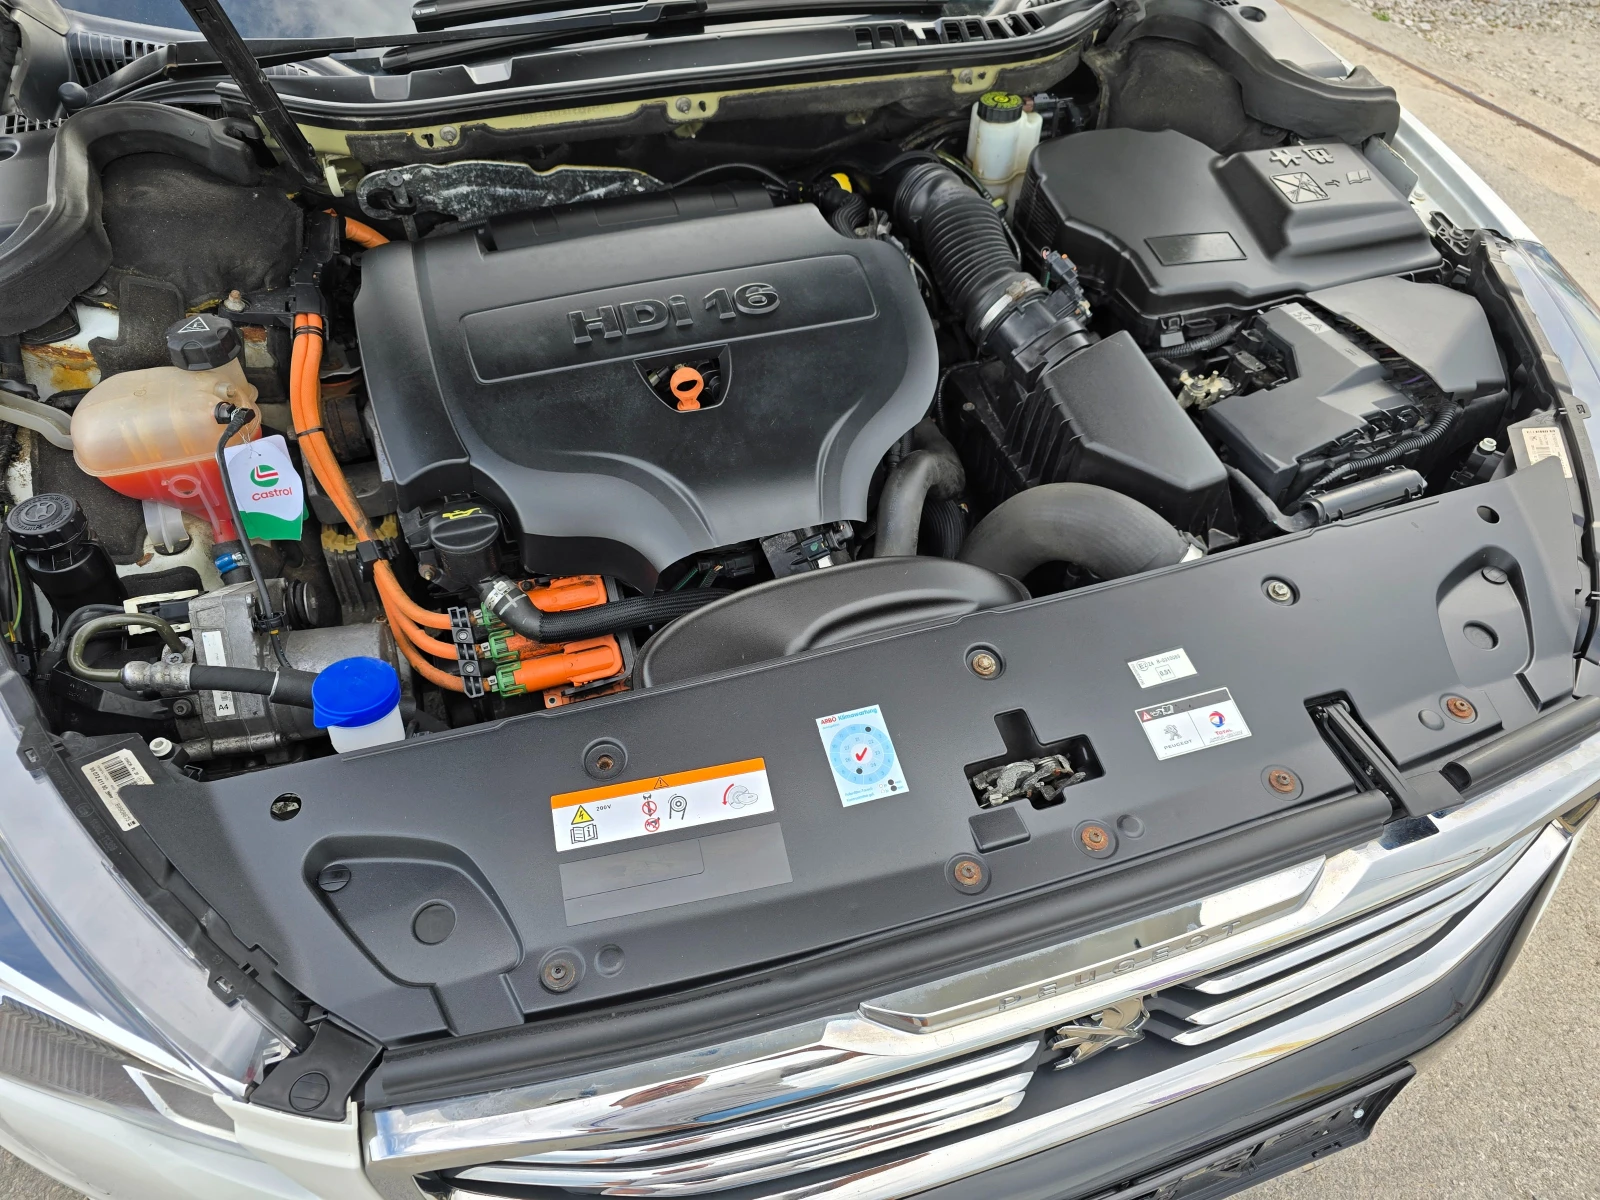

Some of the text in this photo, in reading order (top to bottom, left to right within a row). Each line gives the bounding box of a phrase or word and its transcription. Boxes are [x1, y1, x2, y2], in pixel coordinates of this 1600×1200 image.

[567, 282, 780, 344] HDi 16
[252, 487, 292, 502] Castrol
[838, 708, 878, 720] Klimawartung
[1164, 739, 1192, 750] PEUGEOT
[998, 920, 1240, 1010] PEUGEOT
